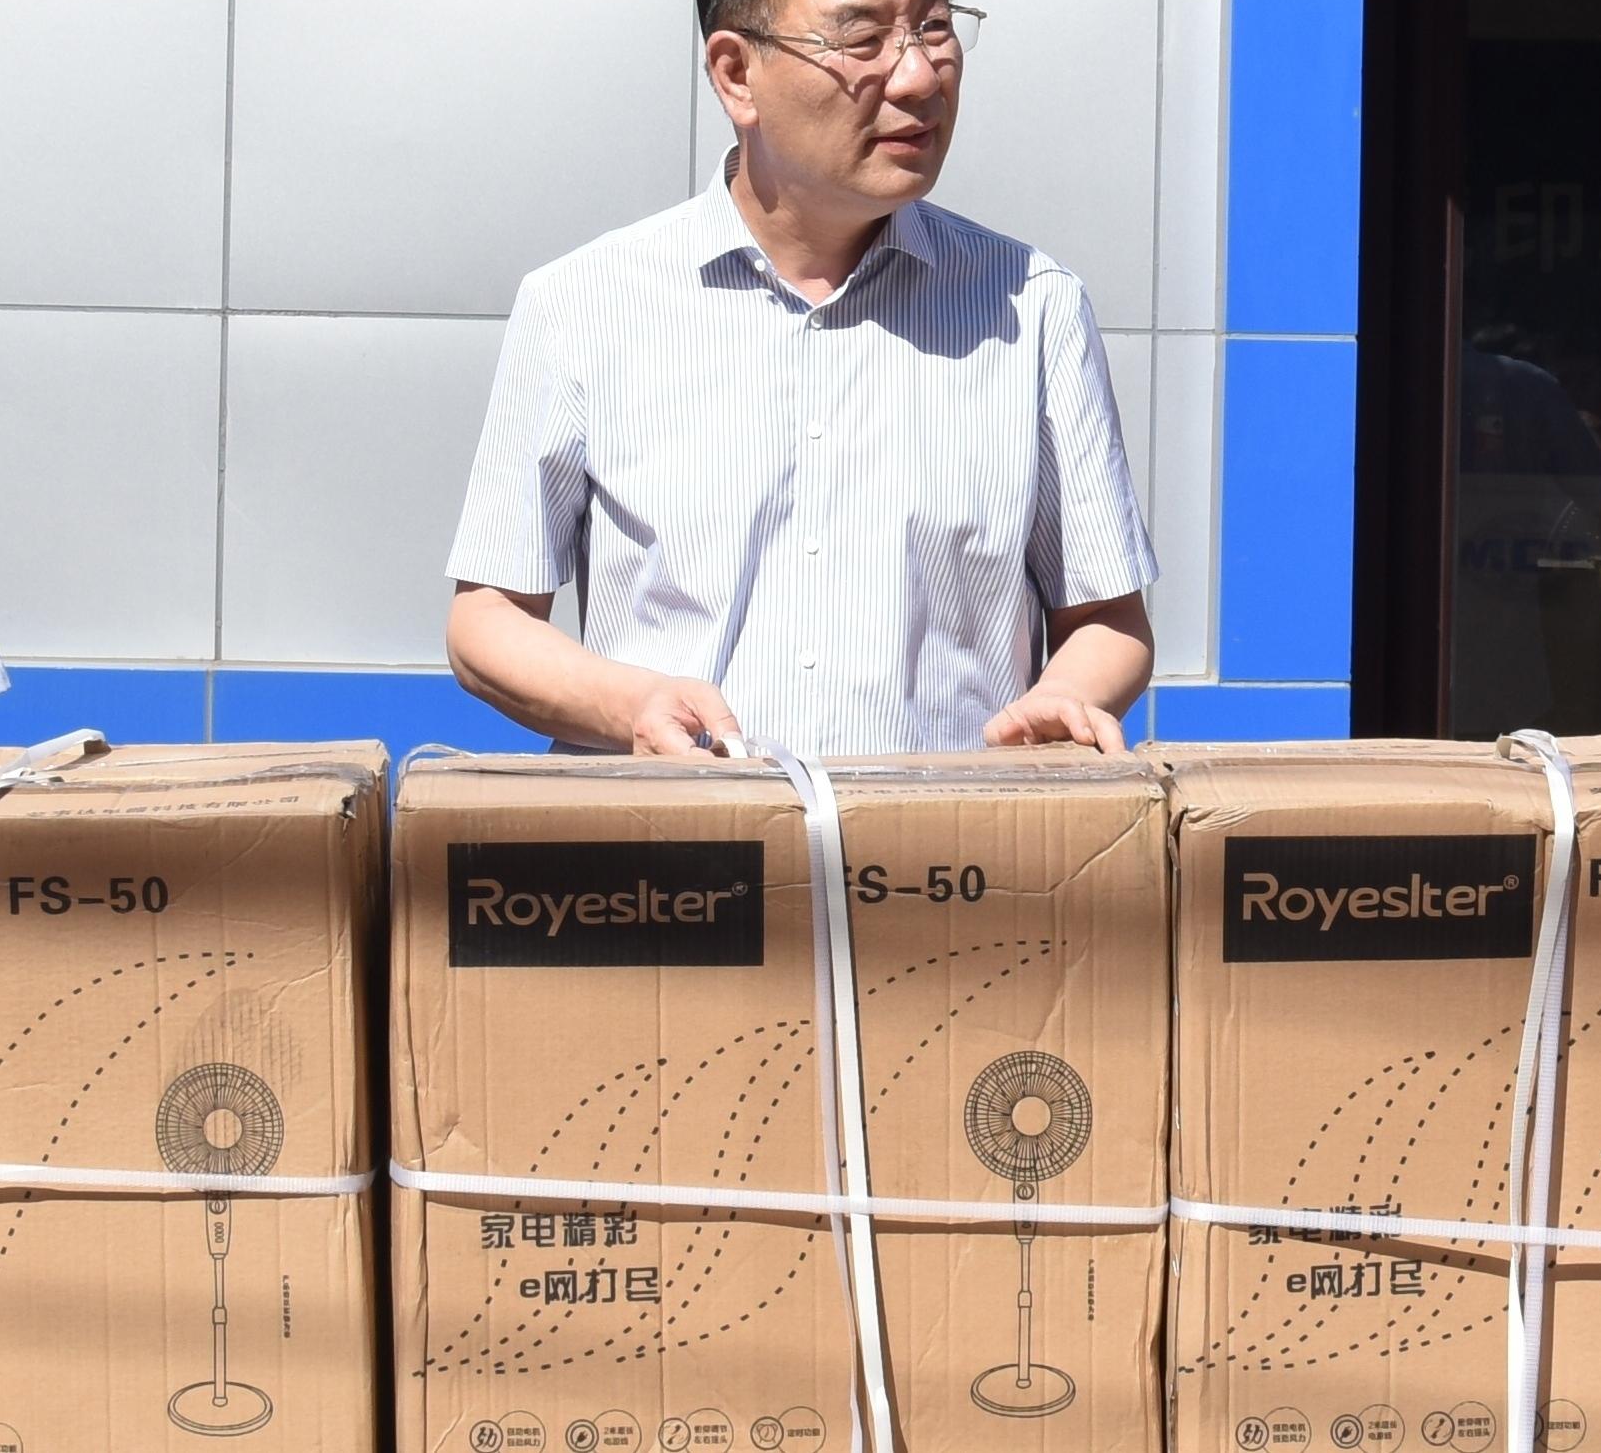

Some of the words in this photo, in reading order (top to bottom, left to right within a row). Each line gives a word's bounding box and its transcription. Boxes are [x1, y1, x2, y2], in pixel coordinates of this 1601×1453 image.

[8, 874, 169, 916] FS-50
[480, 1210, 637, 1249] 家电精彩
[519, 1266, 661, 1305] e网打尽
[1286, 1258, 1426, 1300] e网打尽
